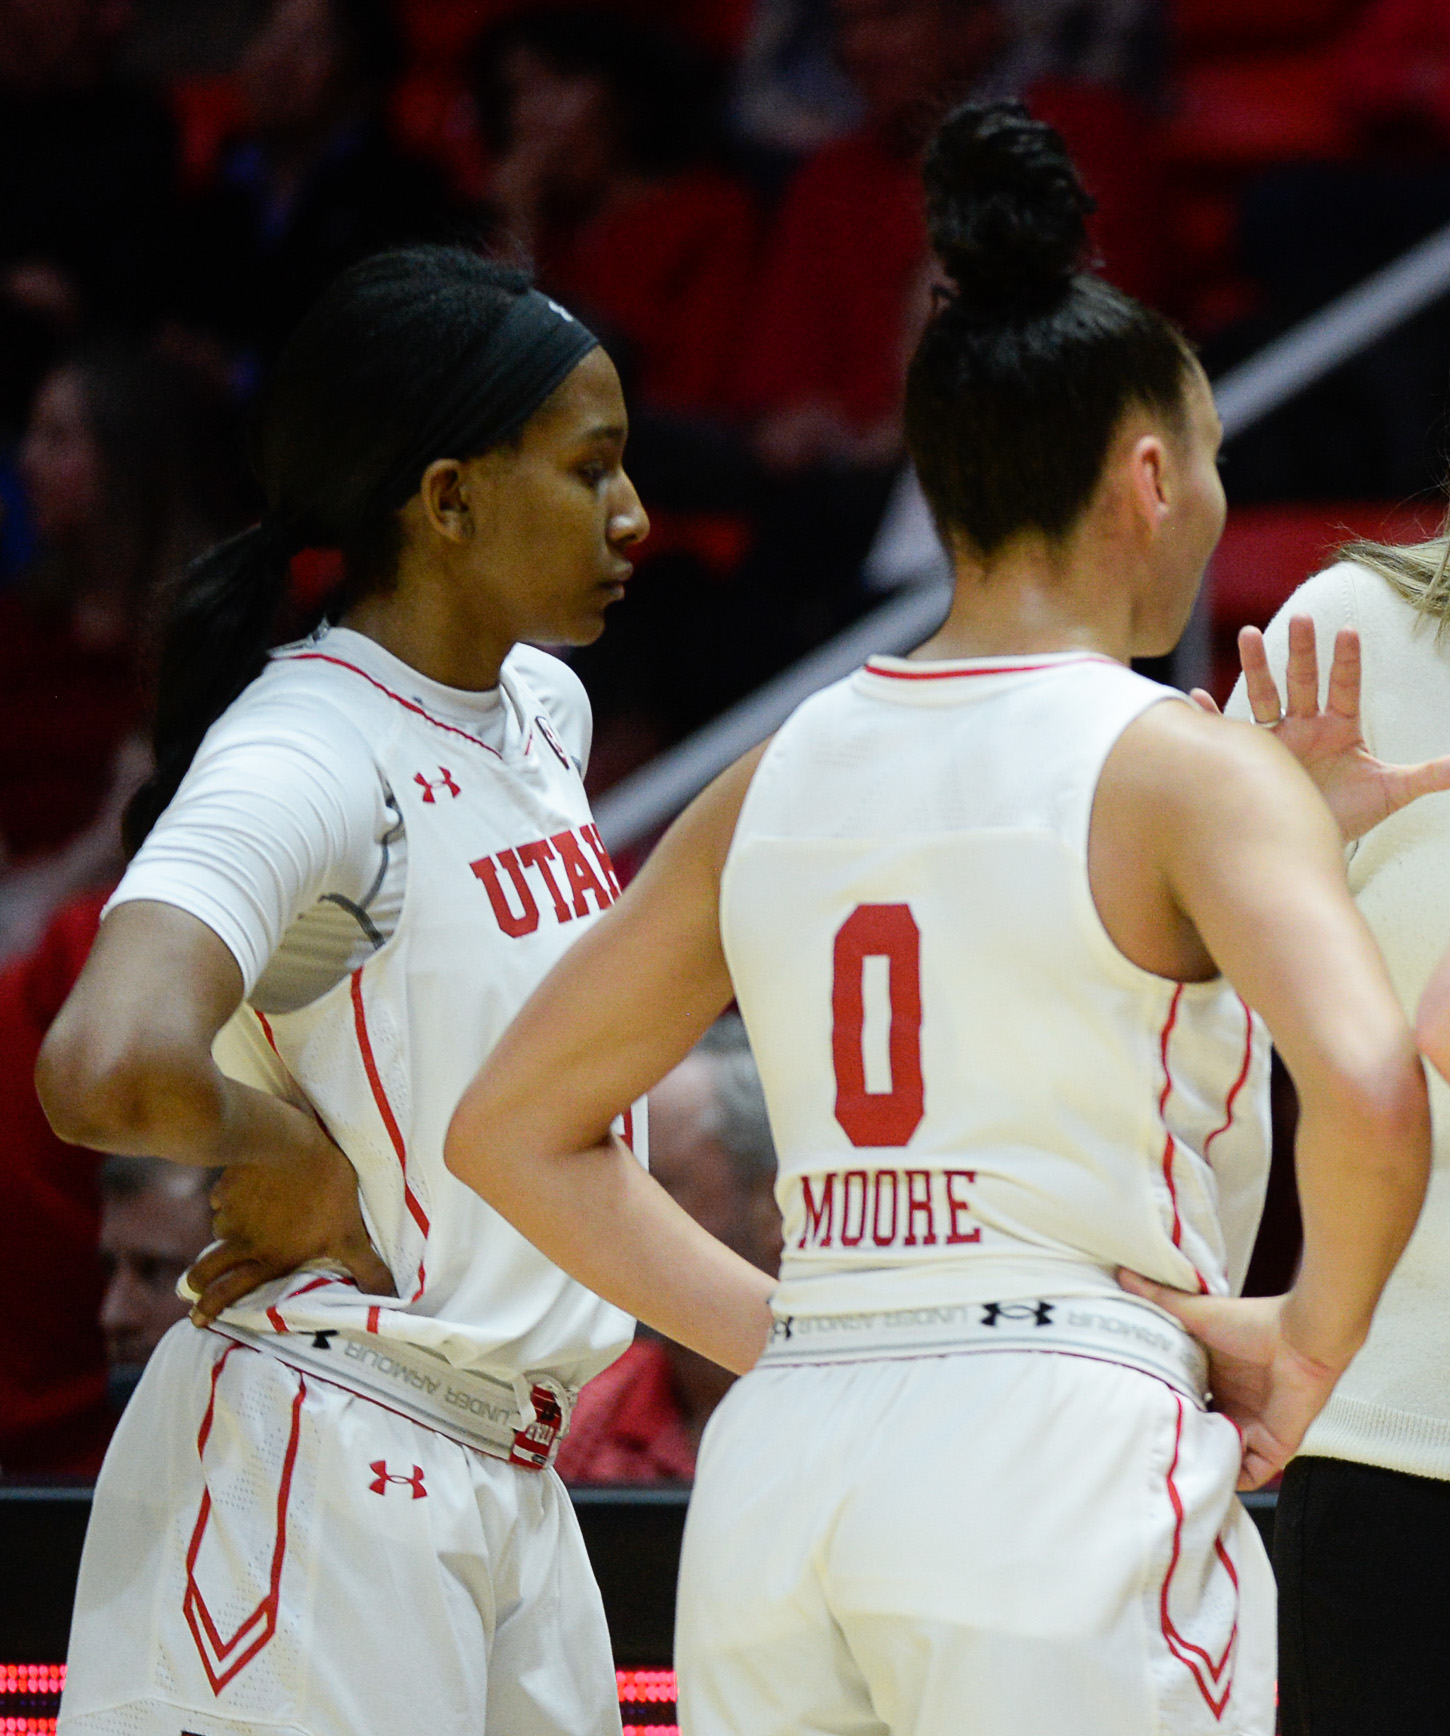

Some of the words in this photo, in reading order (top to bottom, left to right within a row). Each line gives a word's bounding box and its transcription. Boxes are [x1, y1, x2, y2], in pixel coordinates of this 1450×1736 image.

[832, 904, 925, 1146] 0
[798, 1170, 981, 1248] MOORE
[344, 1341, 440, 1395] ARMOUR
[444, 1386, 510, 1426] UNDER
